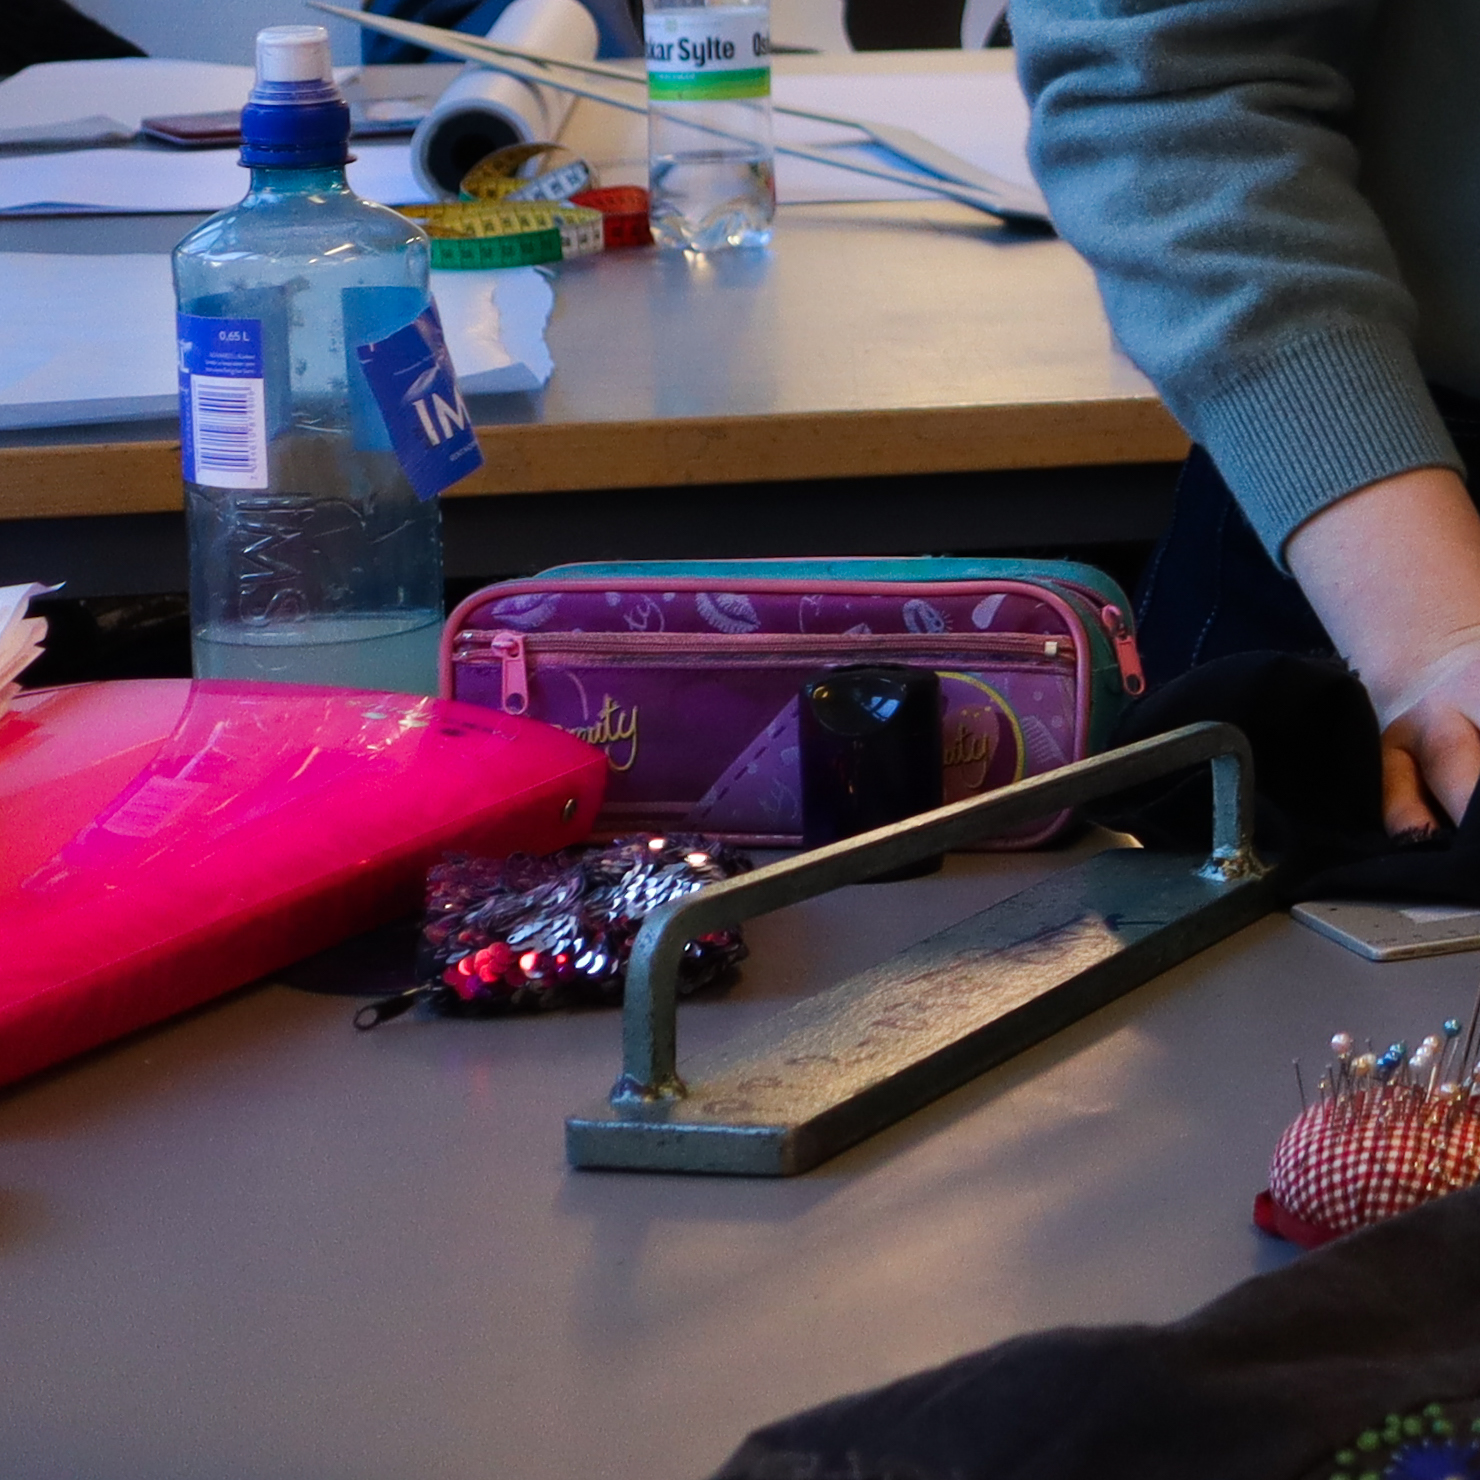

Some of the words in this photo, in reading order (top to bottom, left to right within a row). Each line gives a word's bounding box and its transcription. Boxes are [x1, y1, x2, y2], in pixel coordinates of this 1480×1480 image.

[677, 36, 736, 68] Sylte
[243, 330, 250, 342] L
[944, 723, 989, 789] uty
